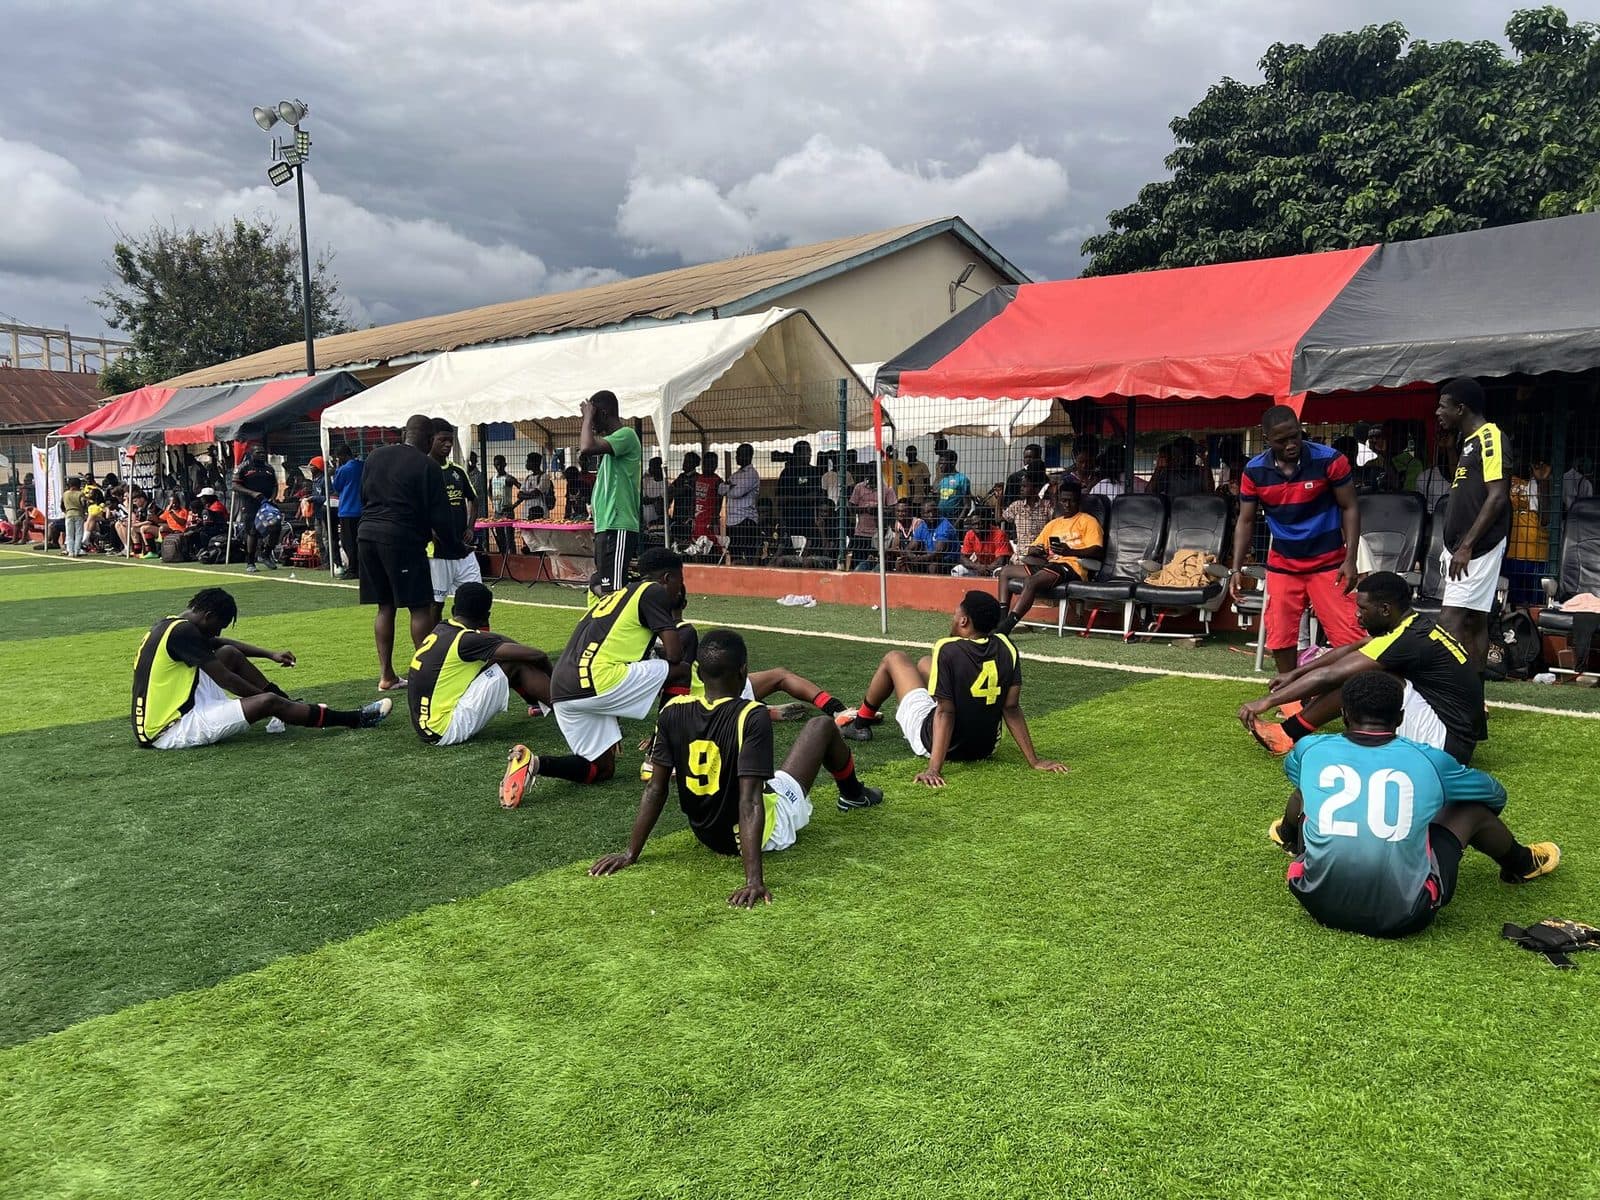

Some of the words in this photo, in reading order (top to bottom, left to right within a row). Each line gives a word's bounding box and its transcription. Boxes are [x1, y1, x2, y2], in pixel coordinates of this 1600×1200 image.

[411, 633, 438, 671] 2
[970, 660, 1001, 705] 4
[685, 739, 721, 796] 9
[1318, 764, 1414, 842] 20
